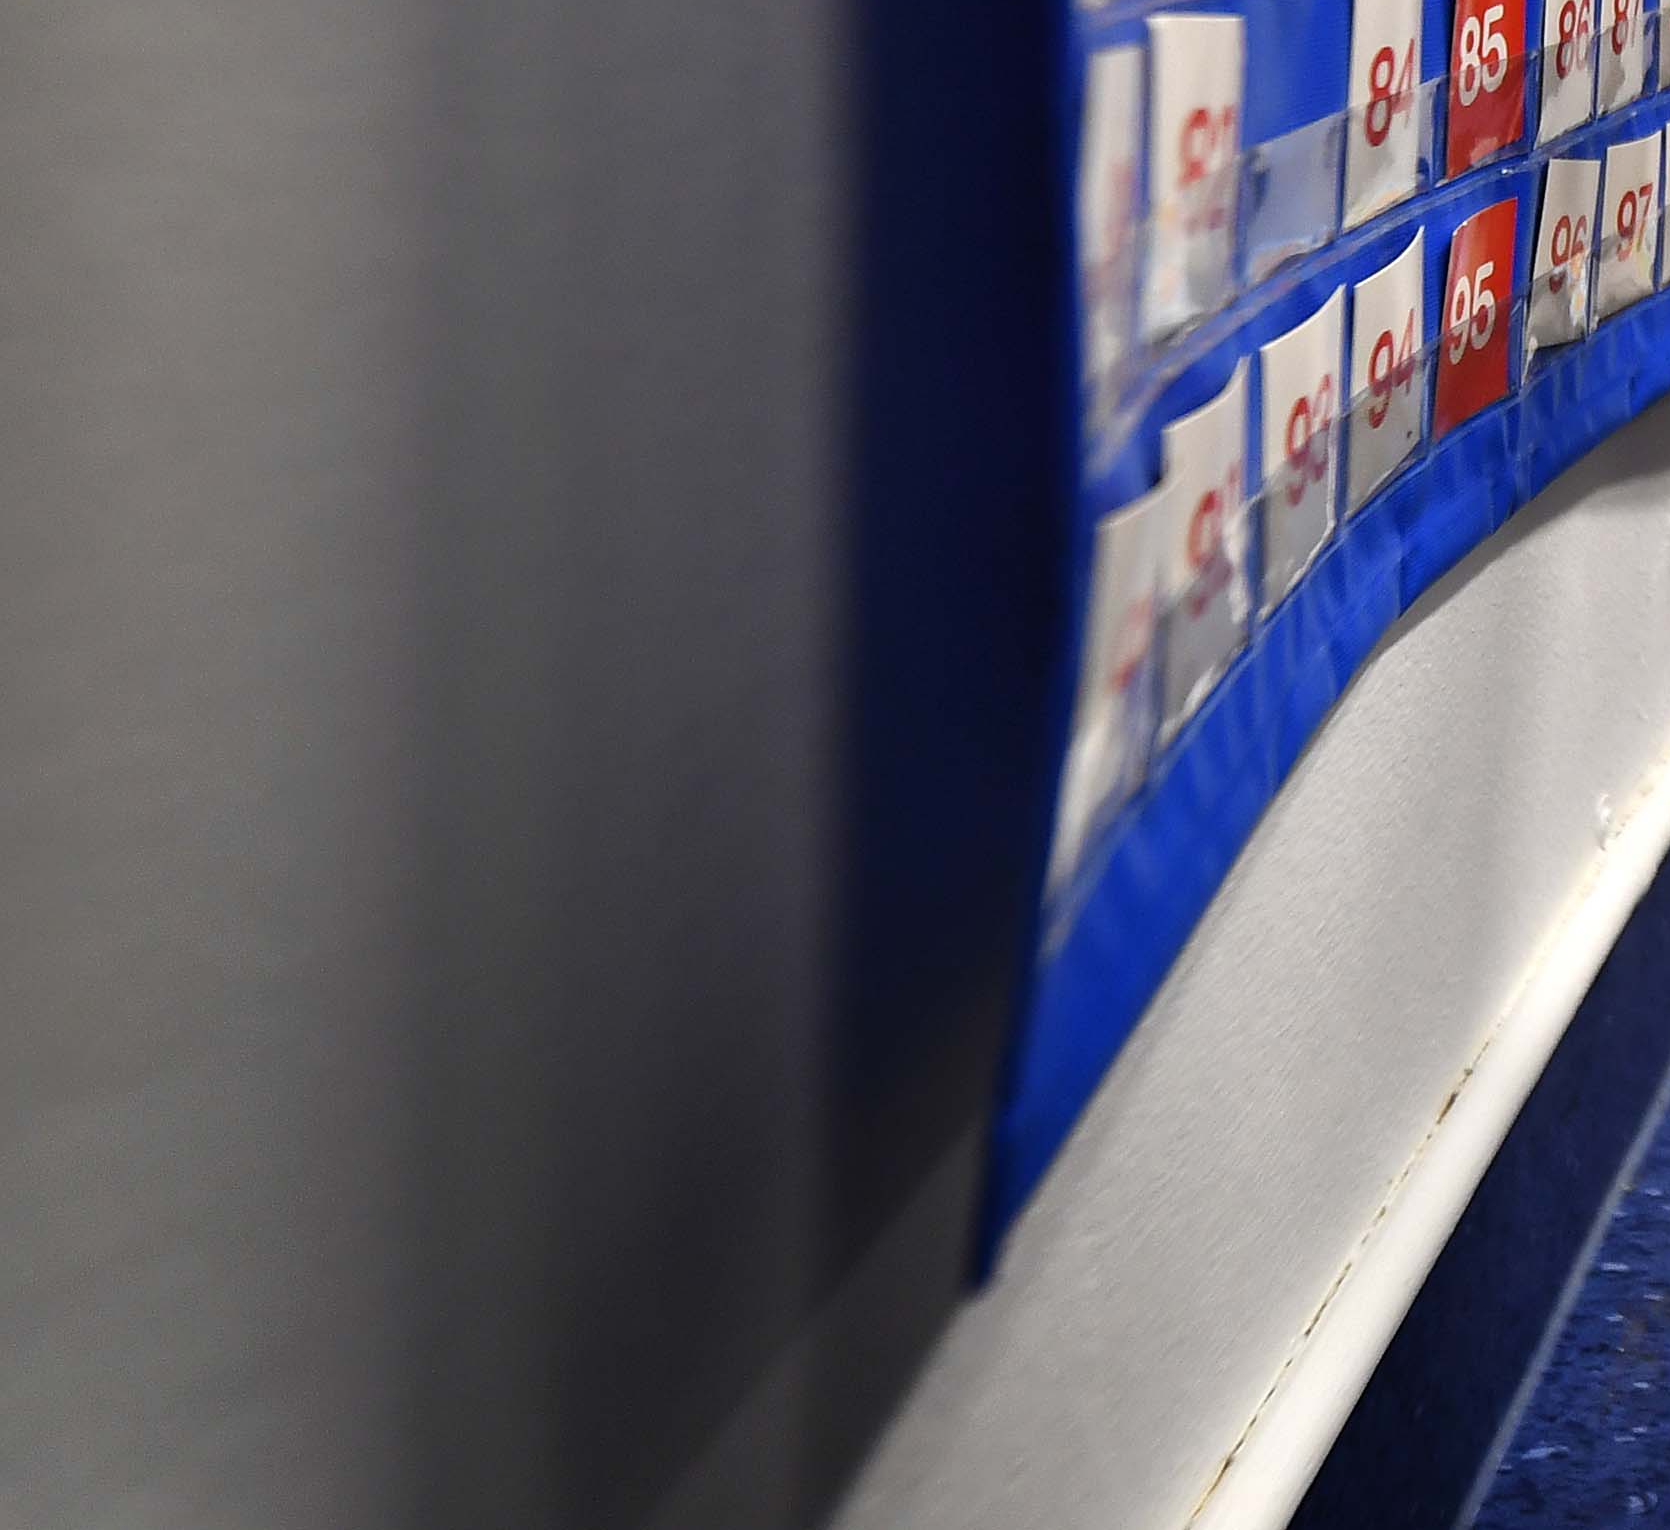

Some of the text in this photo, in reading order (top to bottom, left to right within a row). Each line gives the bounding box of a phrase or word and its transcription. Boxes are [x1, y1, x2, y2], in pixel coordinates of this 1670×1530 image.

[1364, 37, 1415, 146] 84
[1458, 4, 1508, 107] 85
[1616, 182, 1654, 261] 97
[1449, 262, 1496, 365] 95
[1368, 309, 1415, 429] 94
